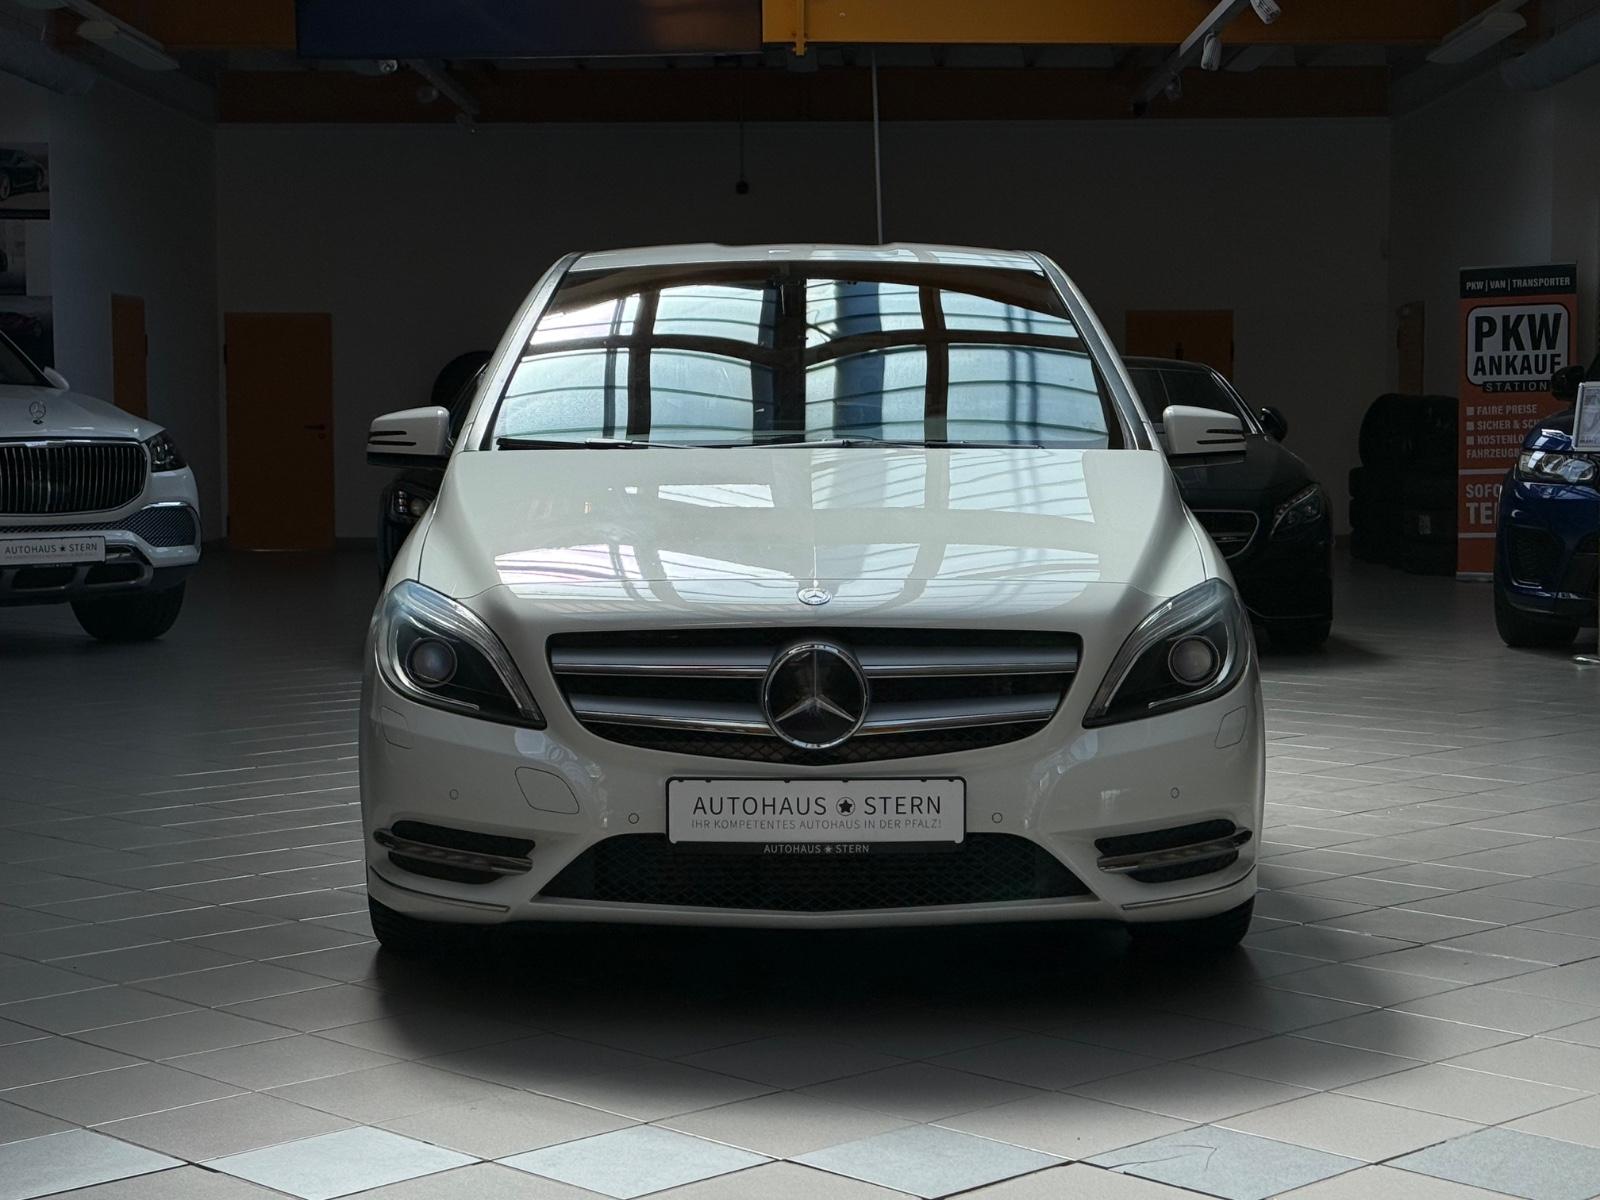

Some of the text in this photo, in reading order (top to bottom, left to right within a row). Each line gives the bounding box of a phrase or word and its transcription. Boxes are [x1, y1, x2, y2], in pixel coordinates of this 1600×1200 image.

[1466, 277, 1570, 290] PKW VAN TRANSPORTER
[1474, 313, 1562, 352] PKW
[1473, 354, 1561, 376] ANKAUF
[1486, 381, 1547, 392] STATION
[1477, 404, 1537, 416] FAIRE PREISE
[1476, 419, 1511, 430] SICHER
[1512, 420, 1520, 429] &
[4, 543, 97, 554] AUTOHAUS STERN
[693, 796, 941, 815] AUTOHAUS STERN
[691, 818, 942, 829] IHR KOMPETENTES AUTOHAUS IN DER PFALZ!
[763, 844, 869, 854] AUTOHAUS STERN
